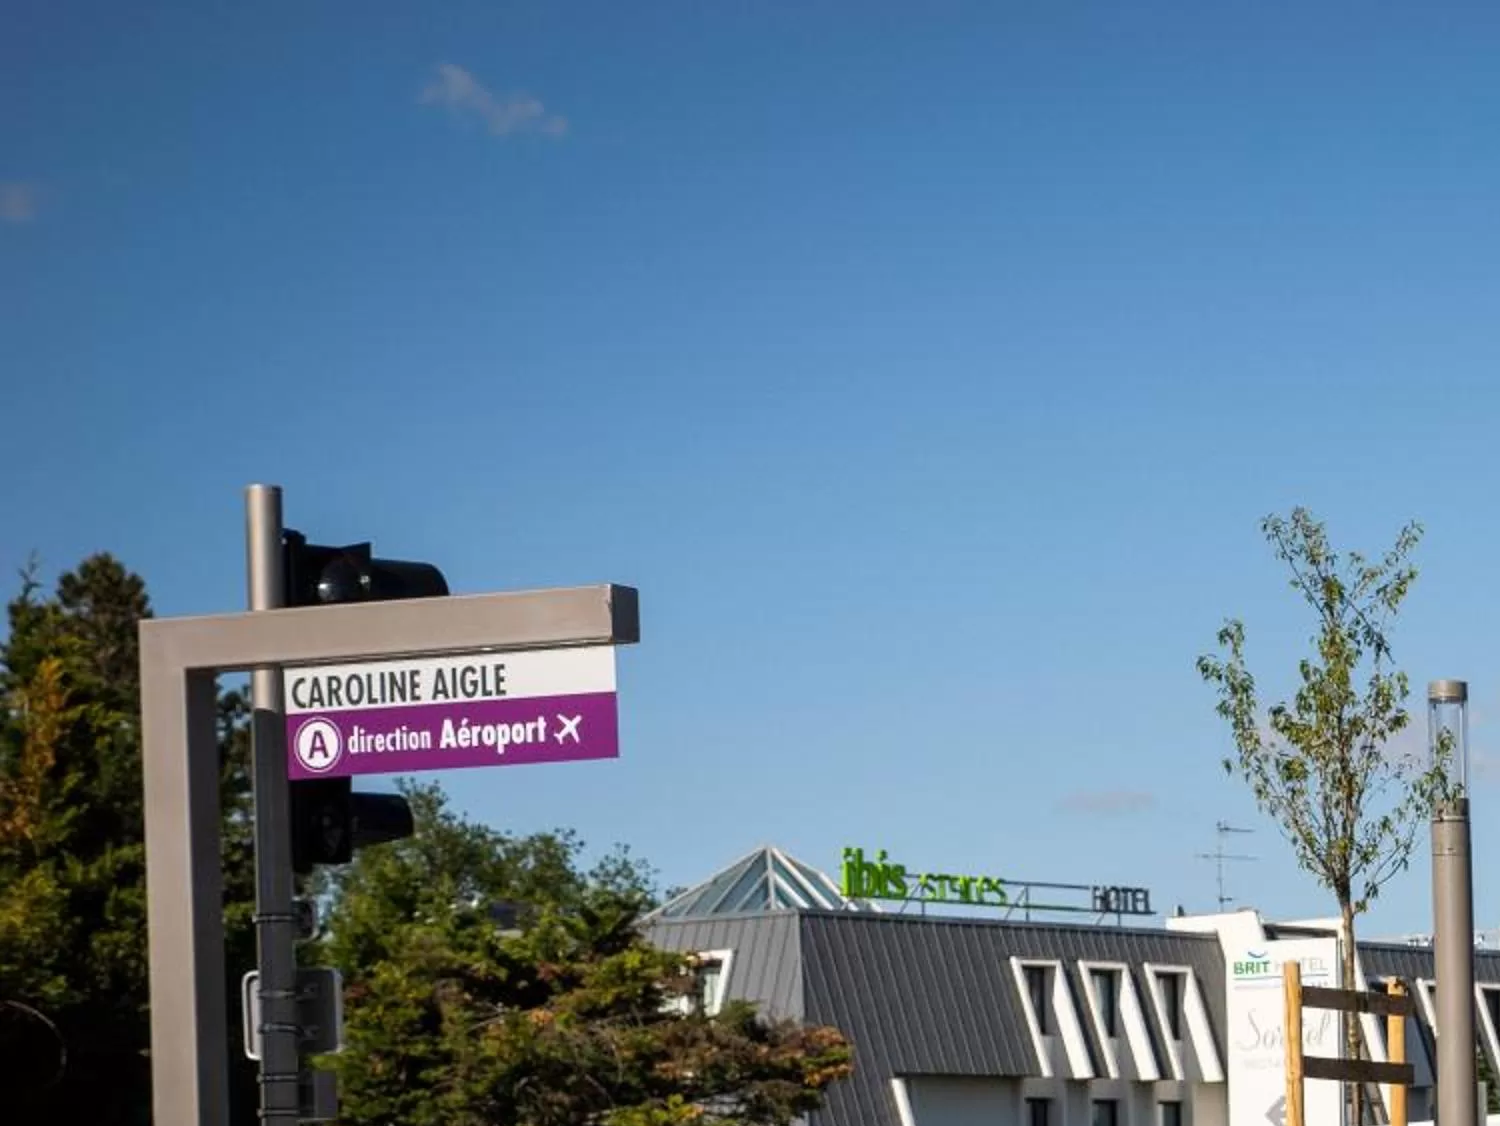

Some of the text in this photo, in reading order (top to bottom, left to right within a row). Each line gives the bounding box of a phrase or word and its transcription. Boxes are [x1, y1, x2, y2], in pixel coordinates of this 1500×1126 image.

[291, 663, 507, 709] CAROLINE AIGLE
[308, 716, 547, 759] A direction Aéroport
[1233, 961, 1270, 975] BRIT
